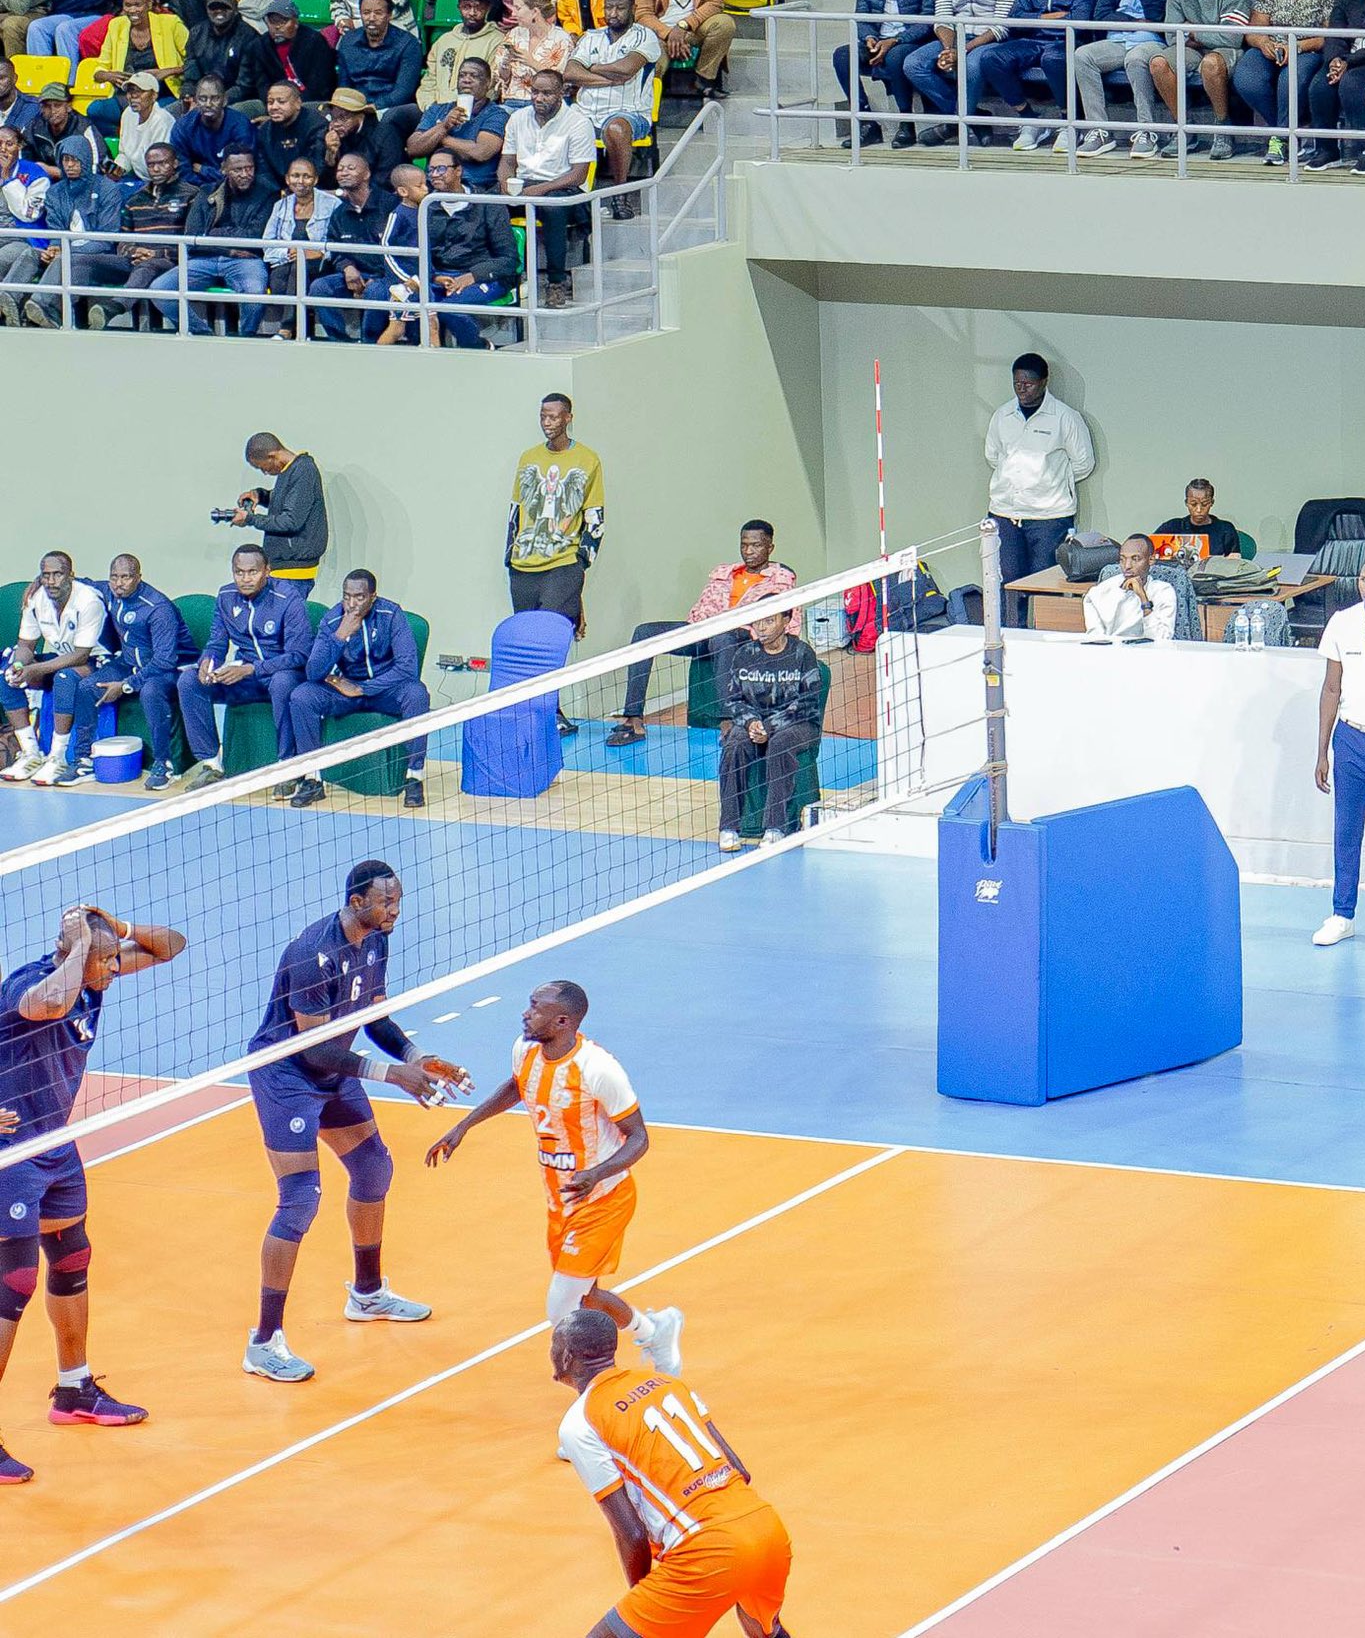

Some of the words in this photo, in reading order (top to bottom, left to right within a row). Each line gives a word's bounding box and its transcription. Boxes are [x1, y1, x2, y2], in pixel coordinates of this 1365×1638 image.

[738, 668, 776, 683] Calvin
[350, 974, 363, 1003] 6
[536, 1105, 554, 1135] 2
[614, 1375, 672, 1413] DJIBRIL
